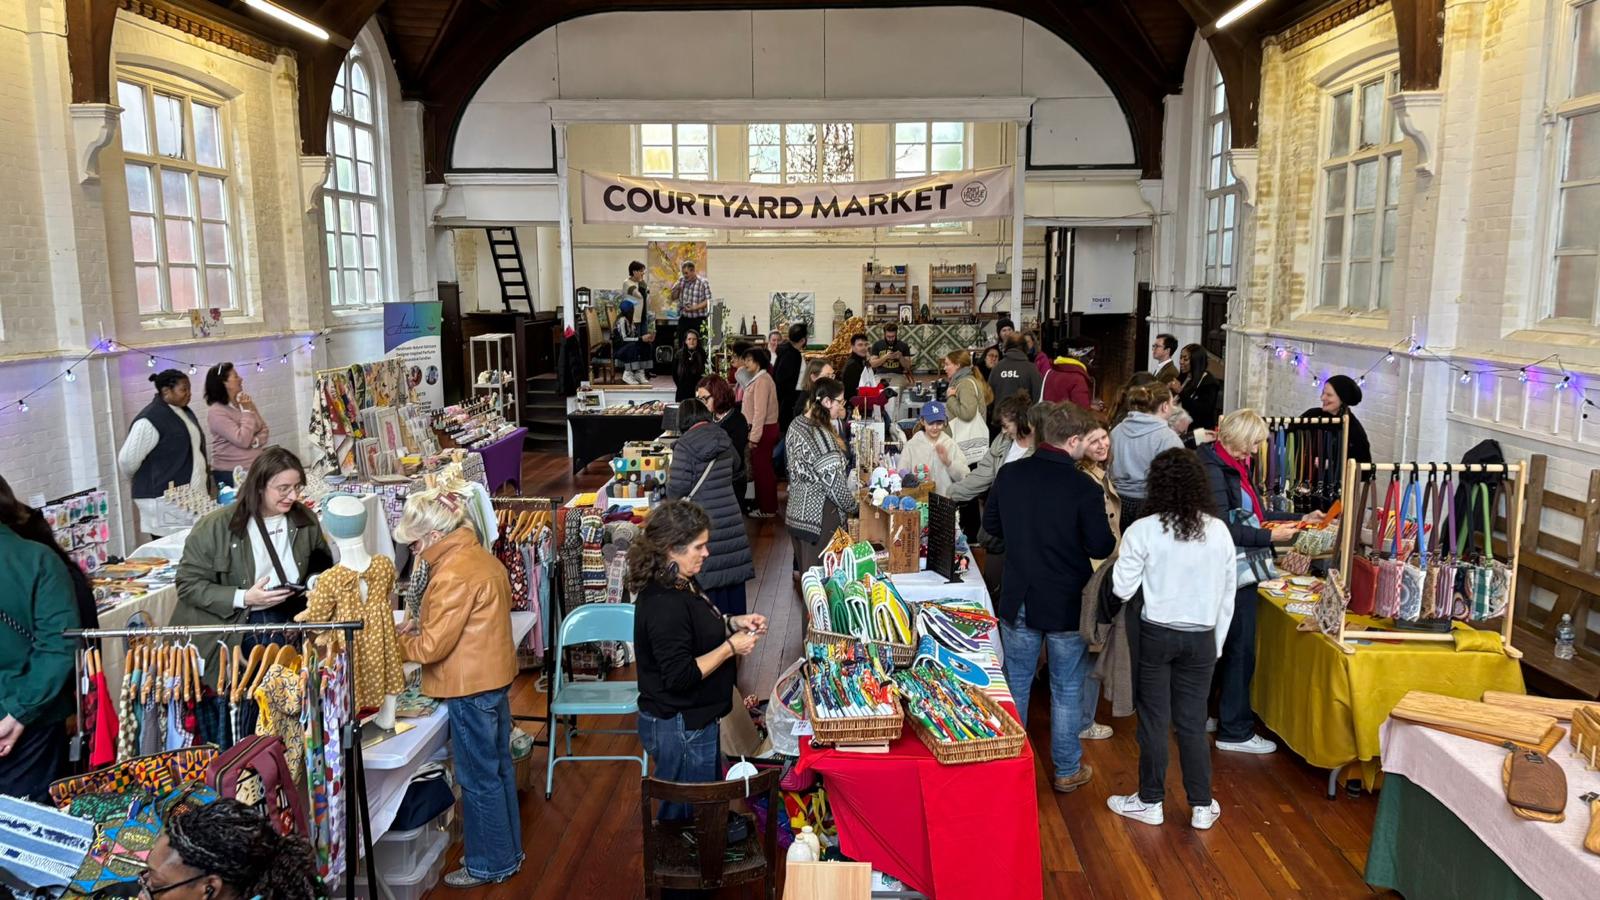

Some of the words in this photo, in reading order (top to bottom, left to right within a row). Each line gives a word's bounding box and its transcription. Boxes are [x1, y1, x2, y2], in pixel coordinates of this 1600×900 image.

[603, 184, 804, 219] COURTYARD
[811, 183, 954, 219] MARKET
[1000, 370, 1020, 378] GSL
